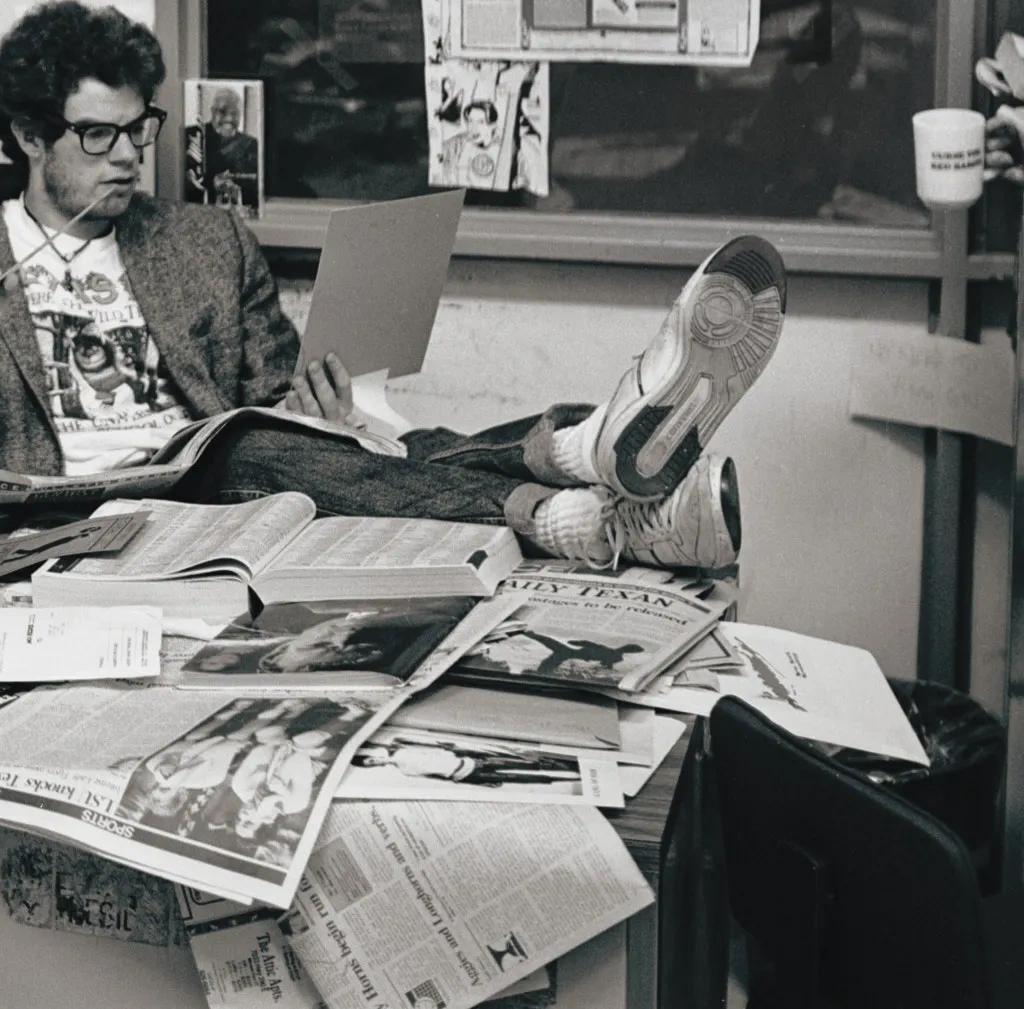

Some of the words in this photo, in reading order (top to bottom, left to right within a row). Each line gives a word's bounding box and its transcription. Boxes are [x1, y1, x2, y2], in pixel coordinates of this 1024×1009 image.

[503, 578, 567, 594] AILY
[575, 584, 674, 608] TEXAN
[527, 597, 579, 607] ostages
[626, 606, 688, 626] released
[24, 775, 75, 800] knocks
[78, 788, 115, 813] LSU
[81, 810, 135, 838] SPORTS
[385, 841, 406, 865] and
[309, 892, 329, 919] run
[403, 865, 444, 927] Longhorns
[257, 932, 271, 953] The
[325, 919, 352, 958] begin
[438, 926, 459, 950] and
[262, 955, 279, 977] Attic
[455, 950, 484, 987] Aggies
[349, 958, 379, 1002] Horns
